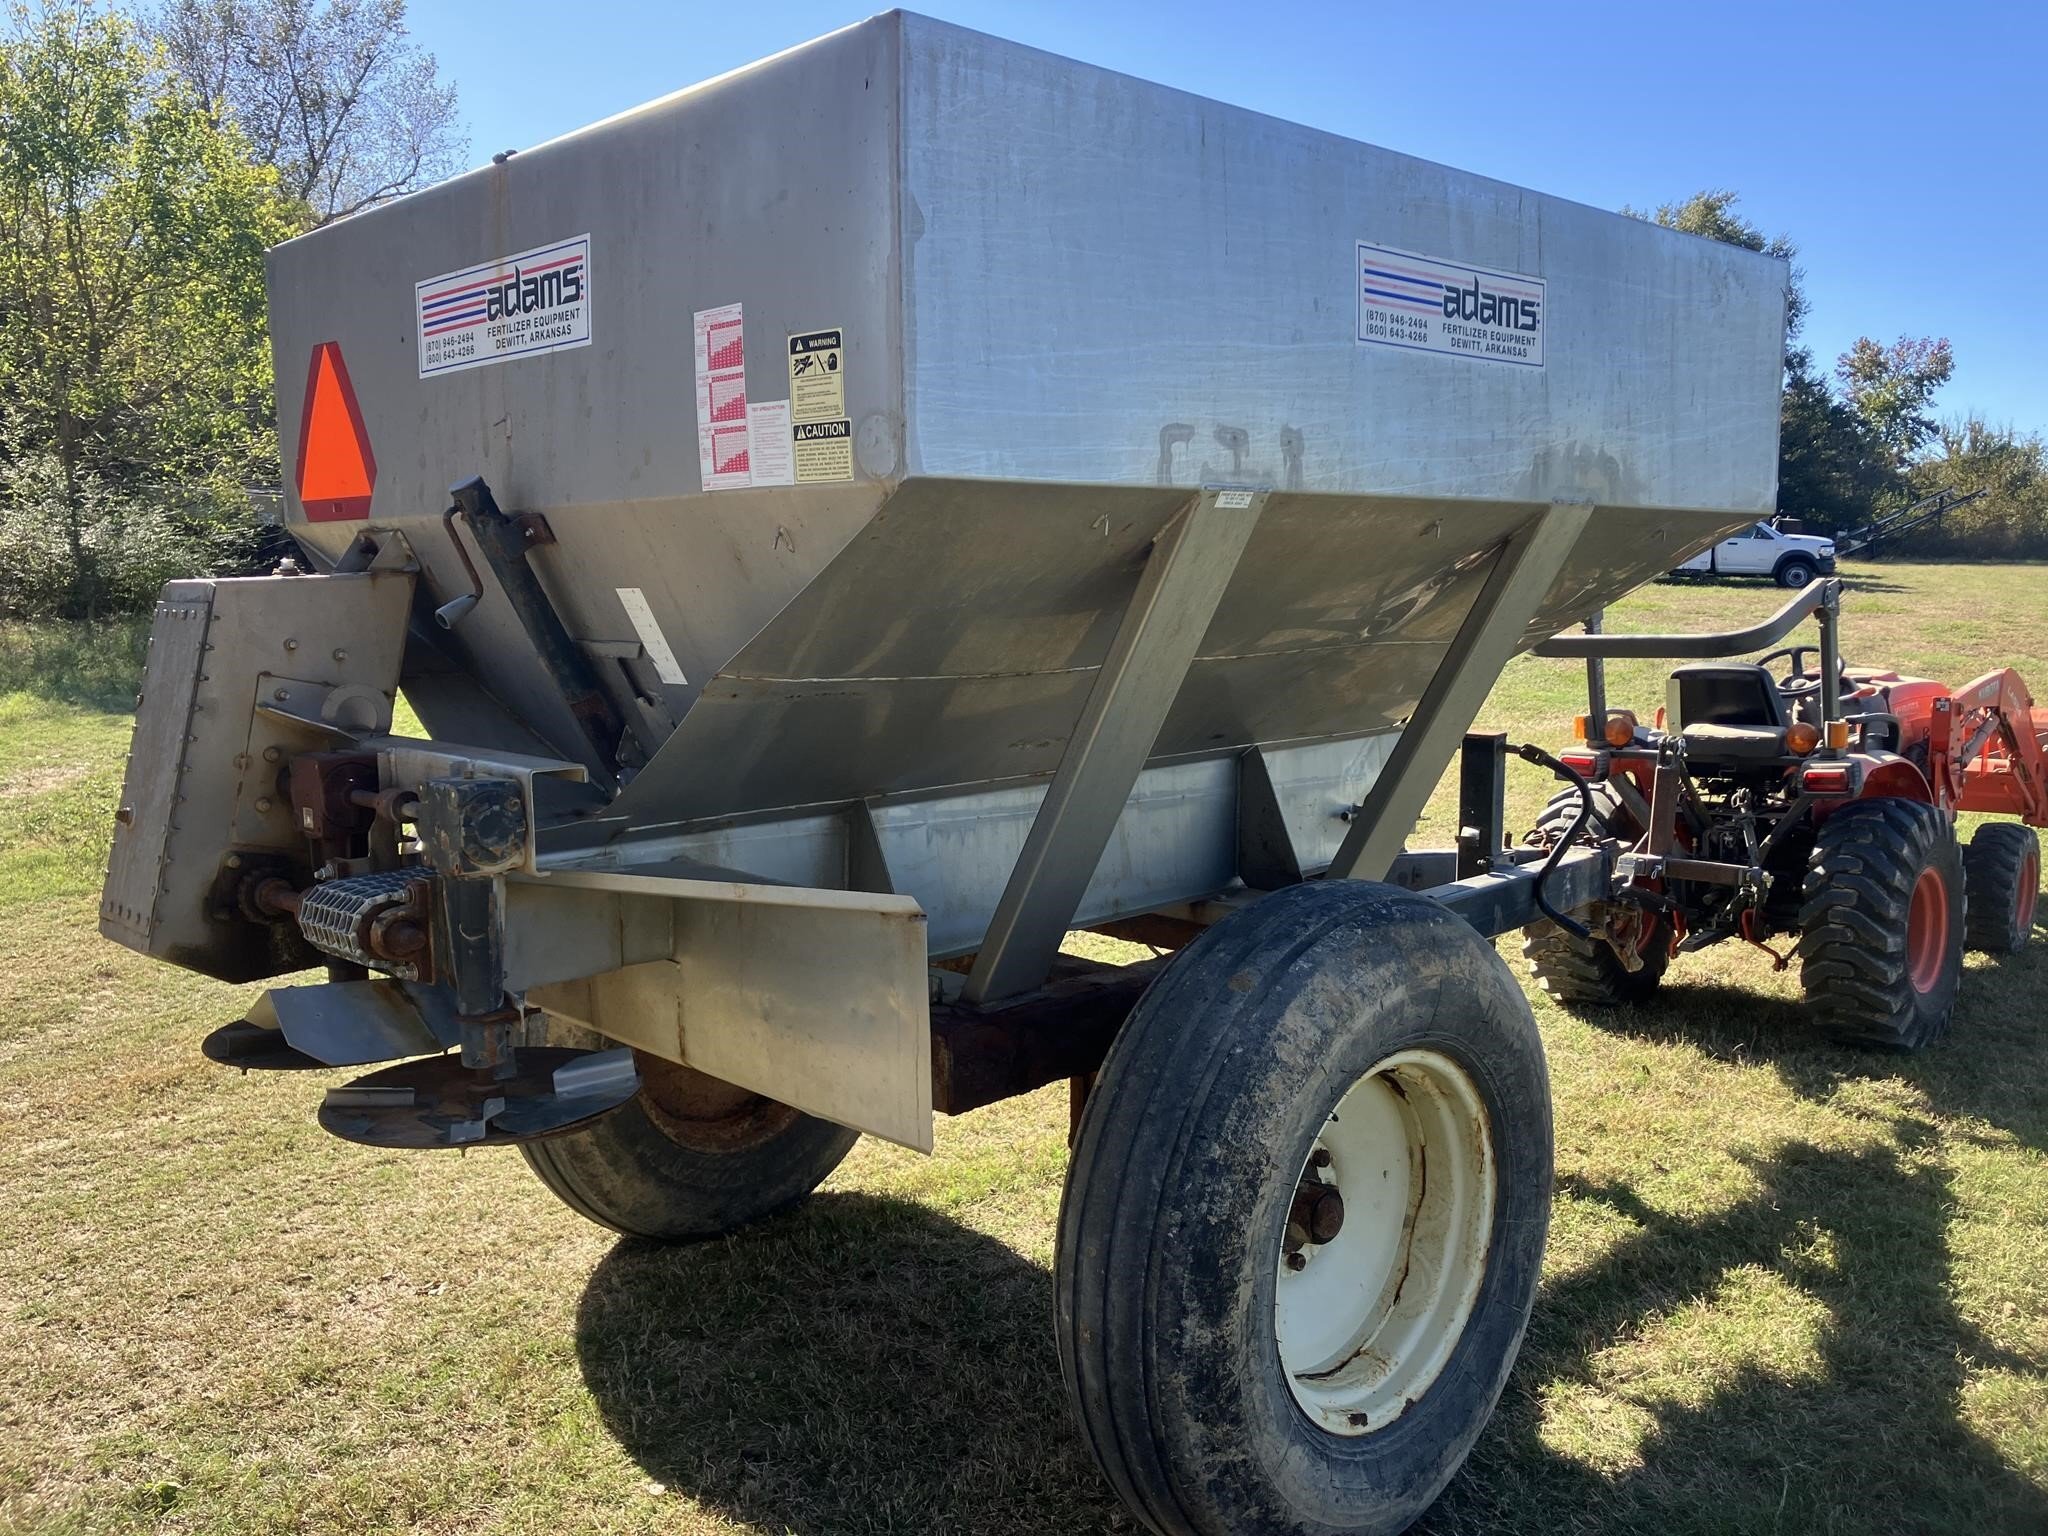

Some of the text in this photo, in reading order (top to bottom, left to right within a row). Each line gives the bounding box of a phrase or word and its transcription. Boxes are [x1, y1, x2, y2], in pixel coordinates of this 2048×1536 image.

[486, 265, 581, 321] adams
[1443, 274, 1537, 331] adams
[487, 308, 580, 338] FERTILIZER EQUIPMENT
[1366, 309, 1428, 329] (870) 946-2494
[426, 332, 474, 354] (870) 946-2494
[496, 324, 572, 350] DEWITT, ARKANSAS
[808, 336, 837, 348] WARNING
[1366, 323, 1428, 343] (800) 643-4266
[1442, 323, 1536, 347] FERTILIZER EQUIPMENT
[426, 344, 475, 366] (800) 643-4266
[1451, 337, 1528, 358] DEWITT, ARKANSAS
[806, 423, 846, 438] CAUTION
